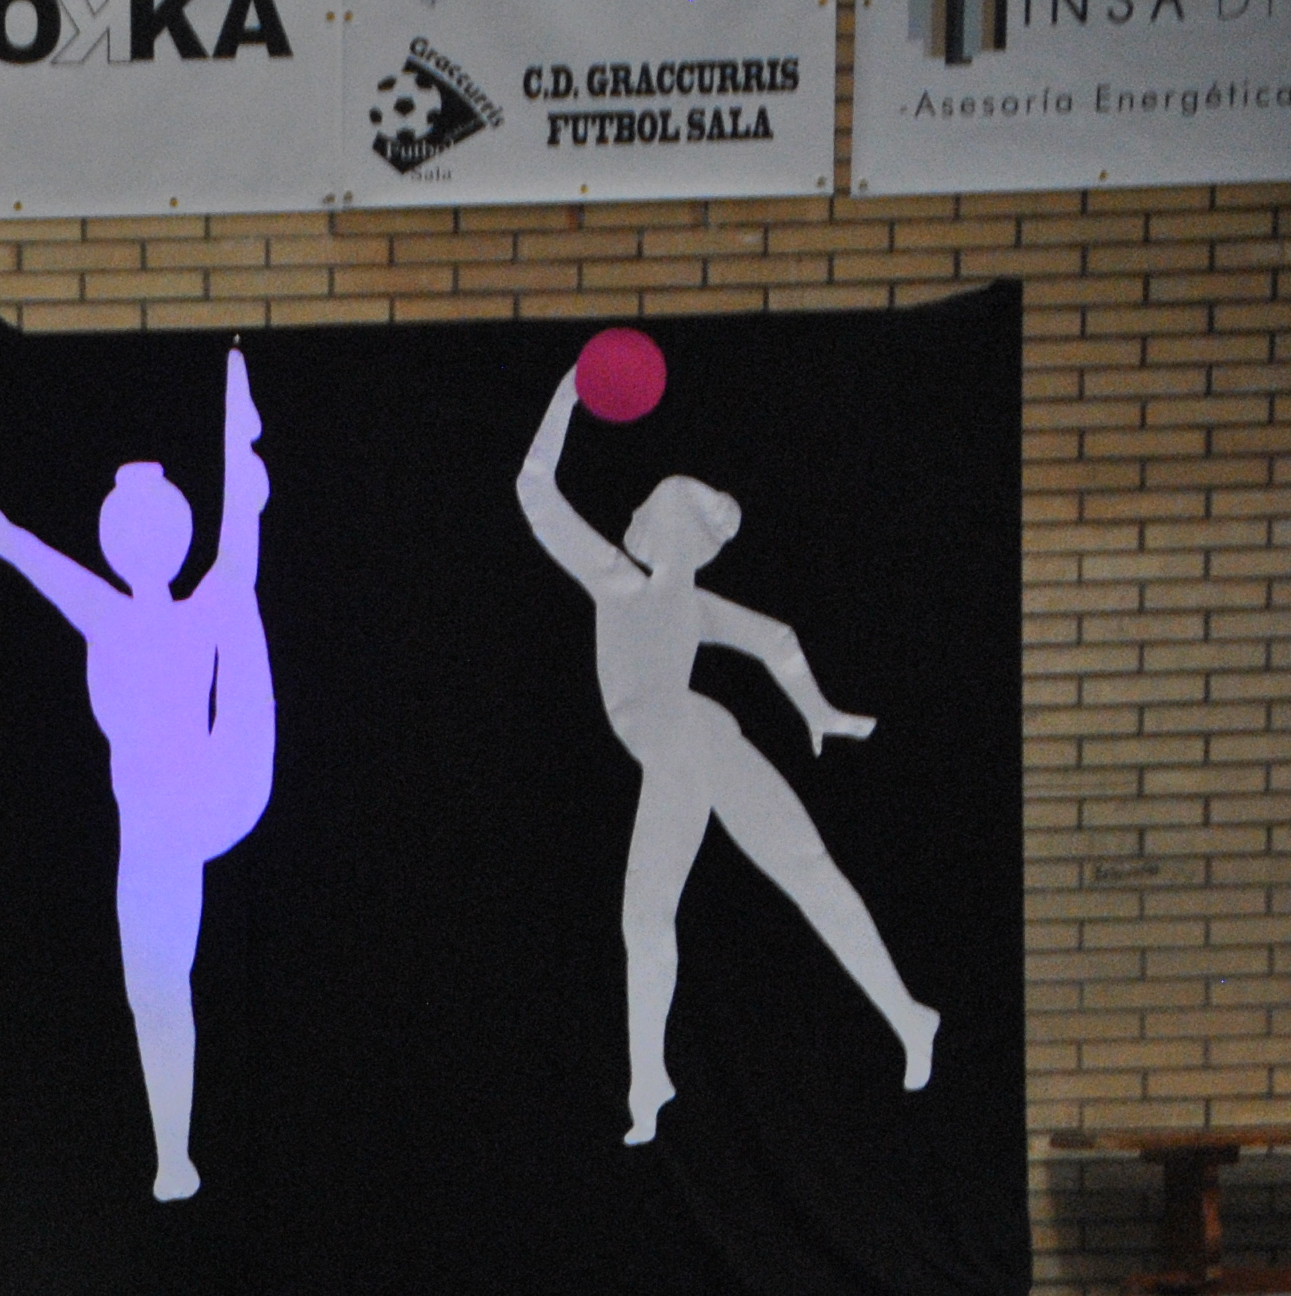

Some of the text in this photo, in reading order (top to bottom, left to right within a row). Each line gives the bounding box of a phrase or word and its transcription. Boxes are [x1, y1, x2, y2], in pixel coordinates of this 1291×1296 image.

[523, 56, 800, 99] C.D. GRACCURRIS
[547, 104, 774, 146] FUTBOL SALA
